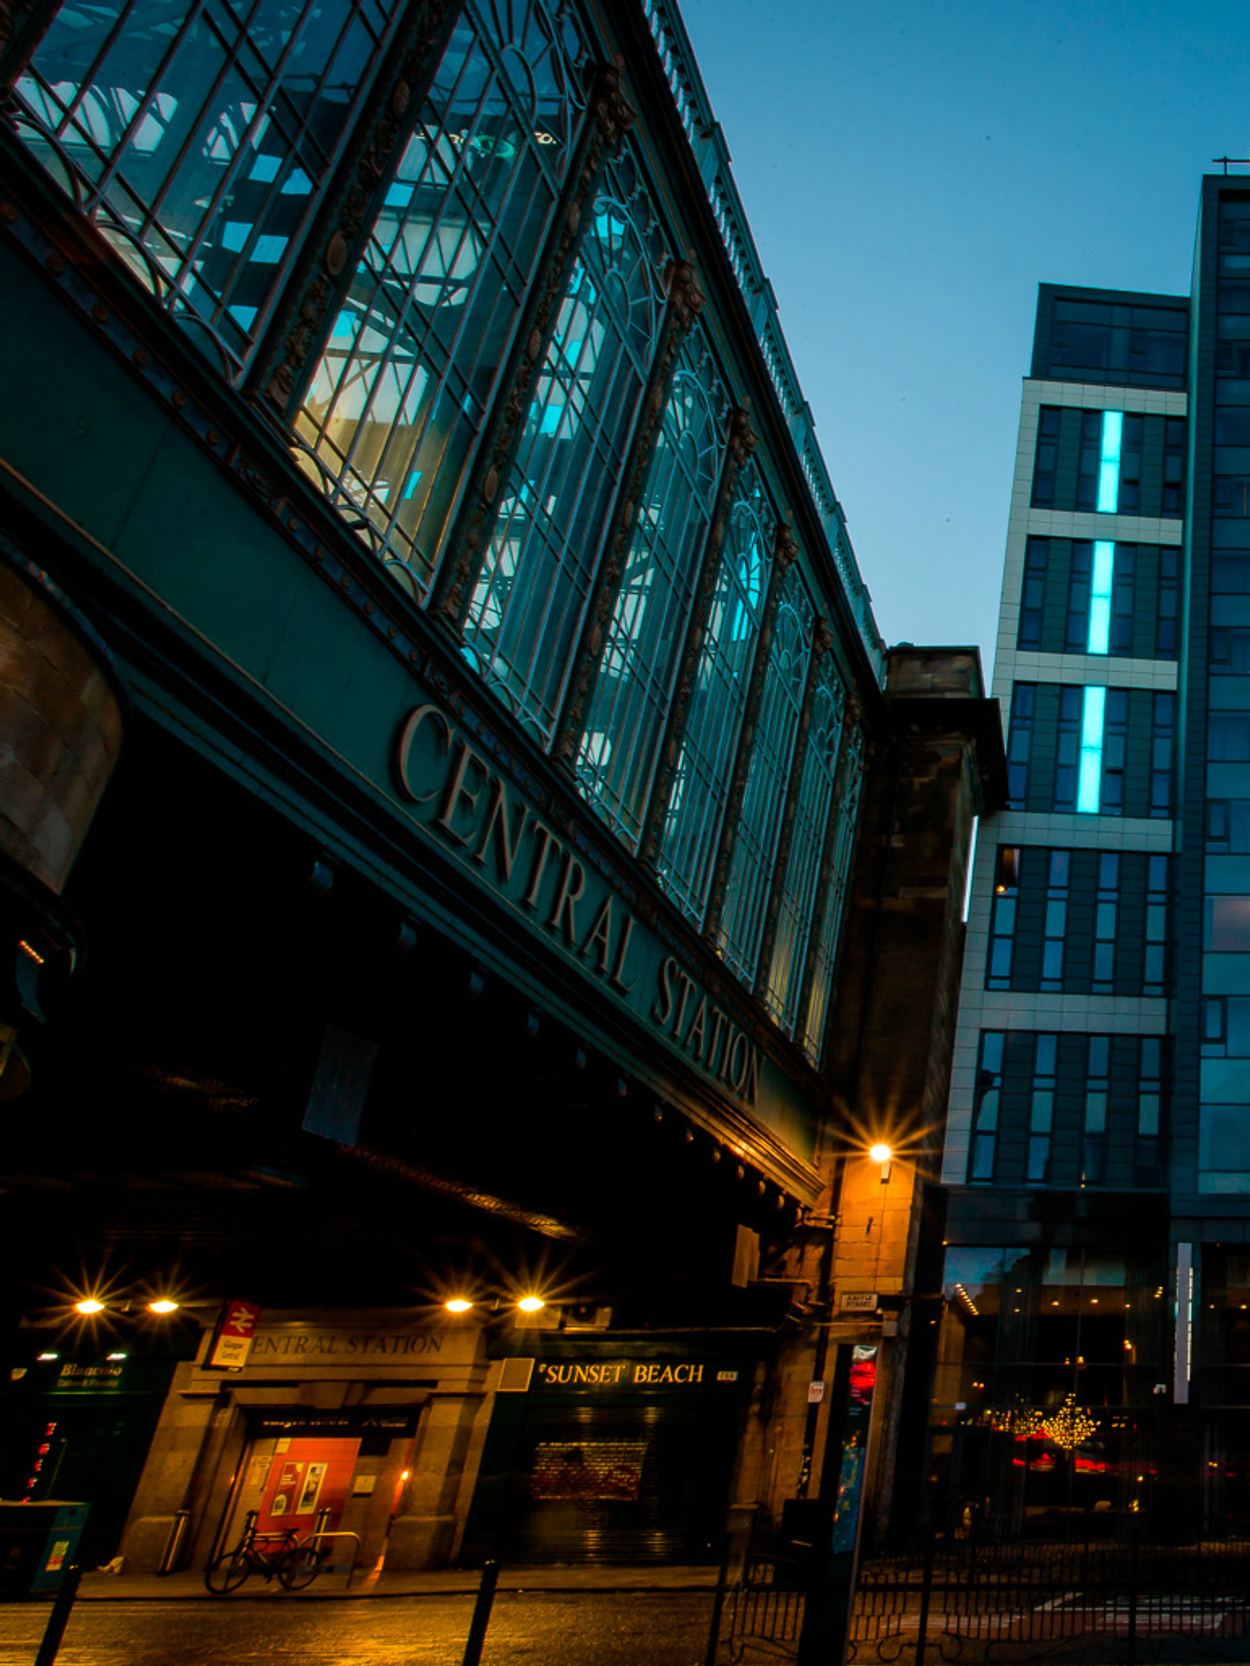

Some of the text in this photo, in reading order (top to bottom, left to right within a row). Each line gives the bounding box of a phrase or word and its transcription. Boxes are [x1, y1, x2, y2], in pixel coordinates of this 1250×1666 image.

[395, 702, 764, 1107] CENTRAL STATION
[251, 1334, 444, 1354] ENTRAL STATION
[632, 1364, 704, 1384] BEACH
